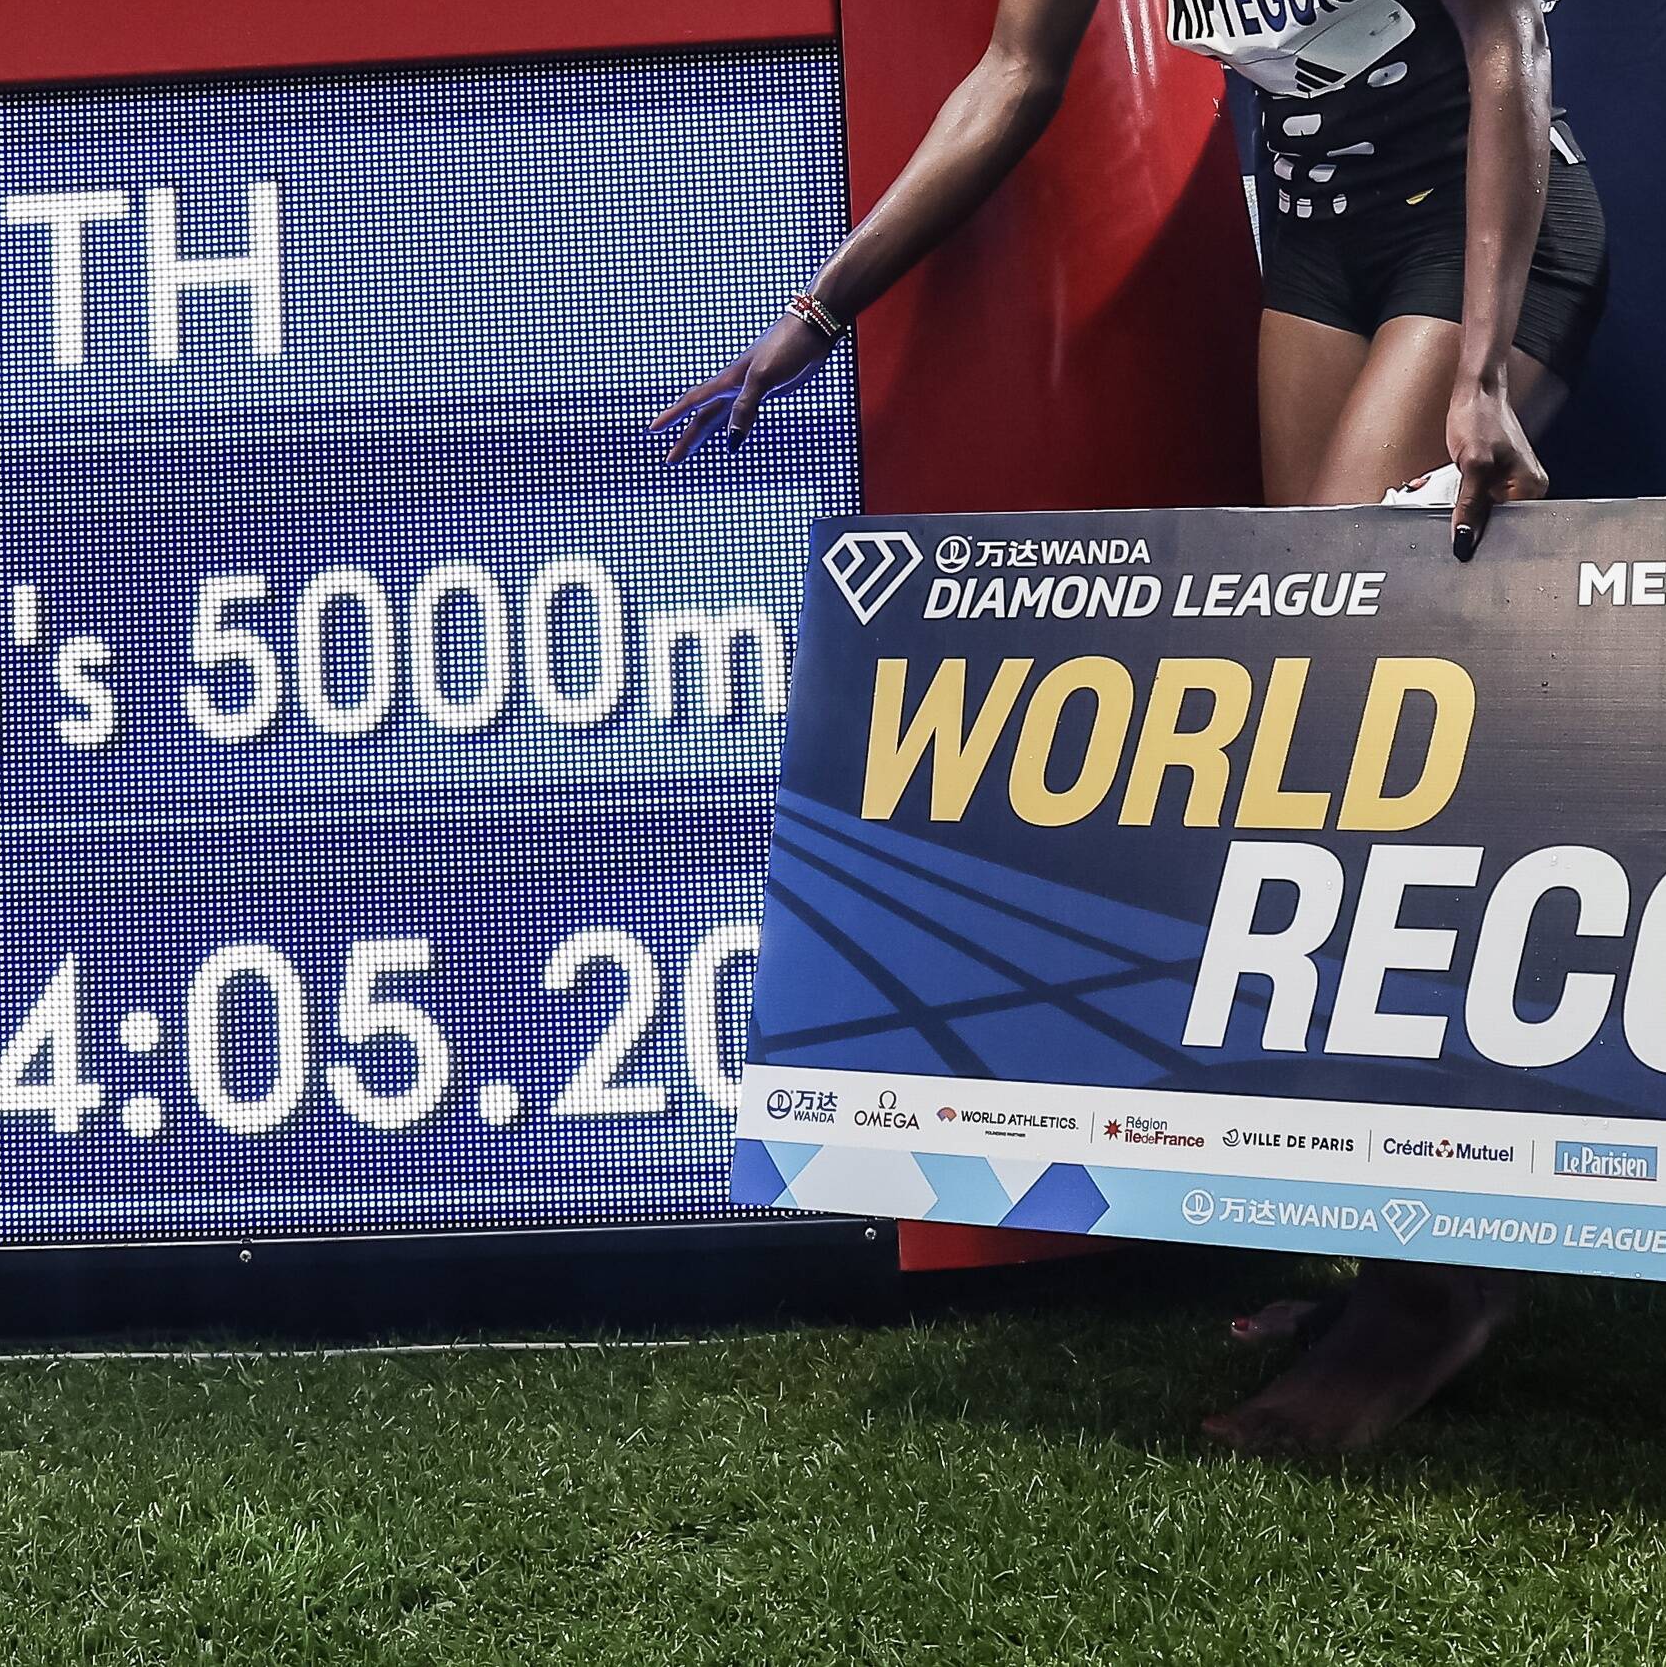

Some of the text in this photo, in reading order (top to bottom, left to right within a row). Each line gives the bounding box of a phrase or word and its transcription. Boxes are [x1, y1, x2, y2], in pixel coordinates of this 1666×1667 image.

[924, 572, 1387, 618] DIAMOND LEAGUE
[186, 554, 788, 744] 5000m
[861, 655, 1476, 832] WORLD
[794, 1091, 838, 1112] 万达
[794, 1111, 835, 1124] WANDA
[854, 1110, 920, 1130] OMEGA
[961, 1110, 1006, 1125] WORLD
[1126, 1116, 1168, 1131] Région
[1243, 1132, 1354, 1152] VILLE DE PARIS
[1383, 1137, 1514, 1162] Crédit Mutuel
[1432, 1214, 1558, 1245] DIAMOND
